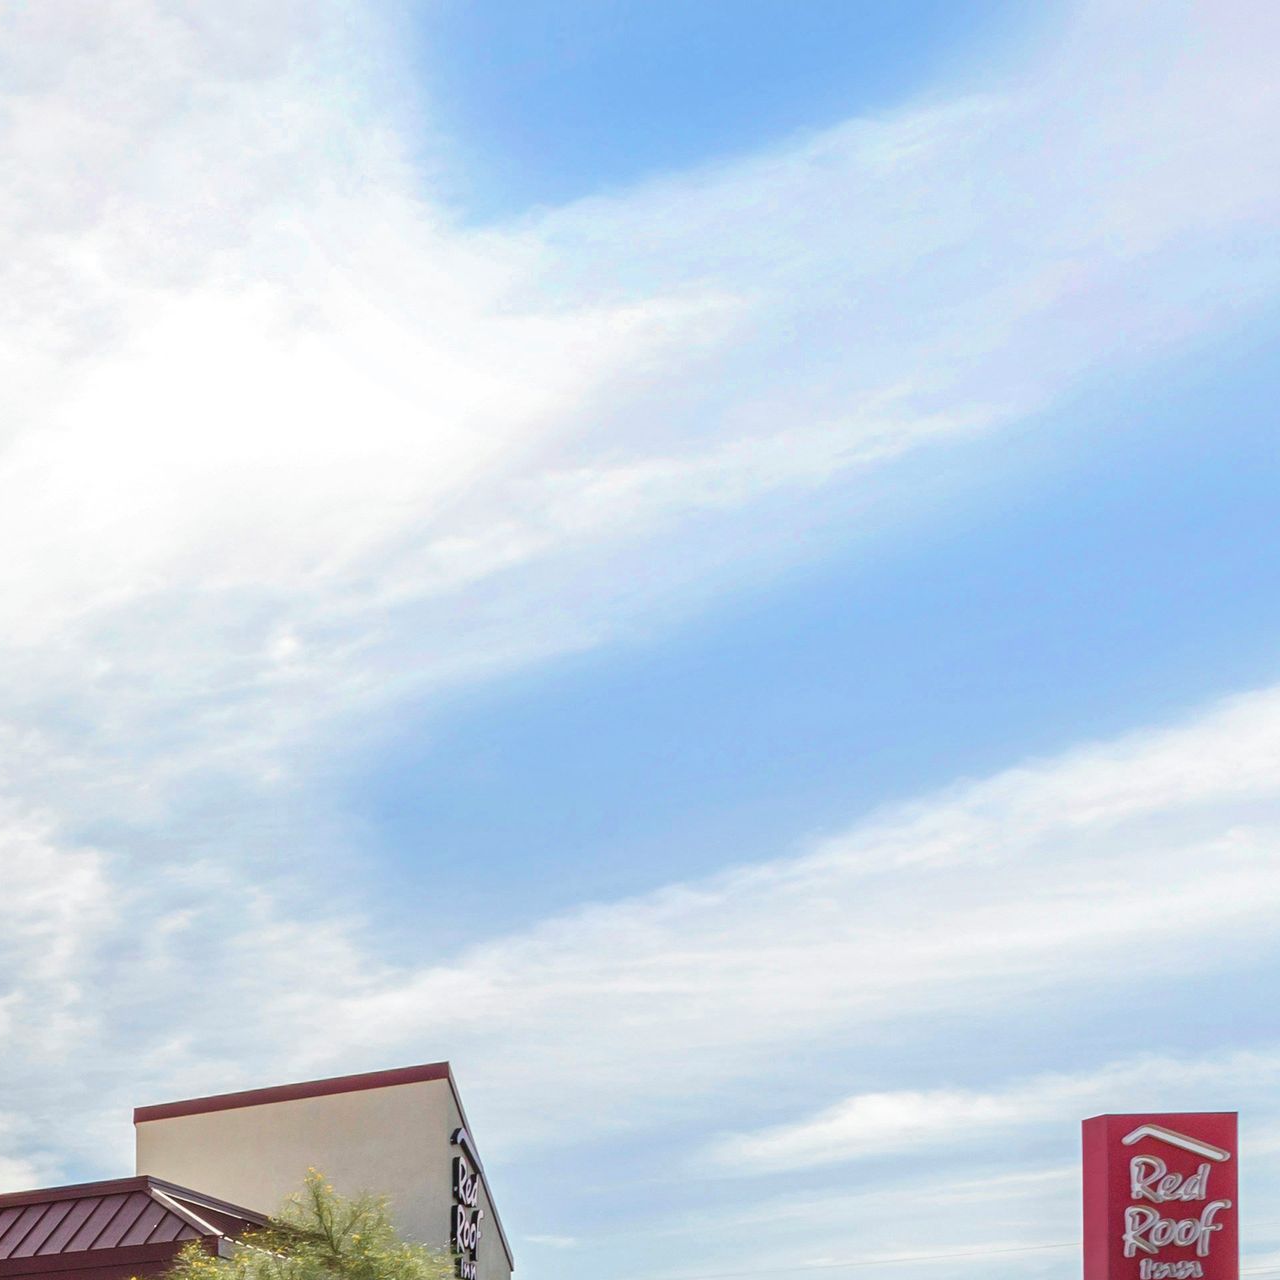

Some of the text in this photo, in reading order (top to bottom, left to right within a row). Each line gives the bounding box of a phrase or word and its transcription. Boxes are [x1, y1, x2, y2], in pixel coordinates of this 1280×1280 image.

[453, 1156, 479, 1207] Red
[1130, 1155, 1211, 1203] Red
[452, 1204, 484, 1261] Roof
[1122, 1200, 1232, 1258] Roof
[456, 1258, 478, 1280] Inn
[1139, 1258, 1204, 1280] Inn
